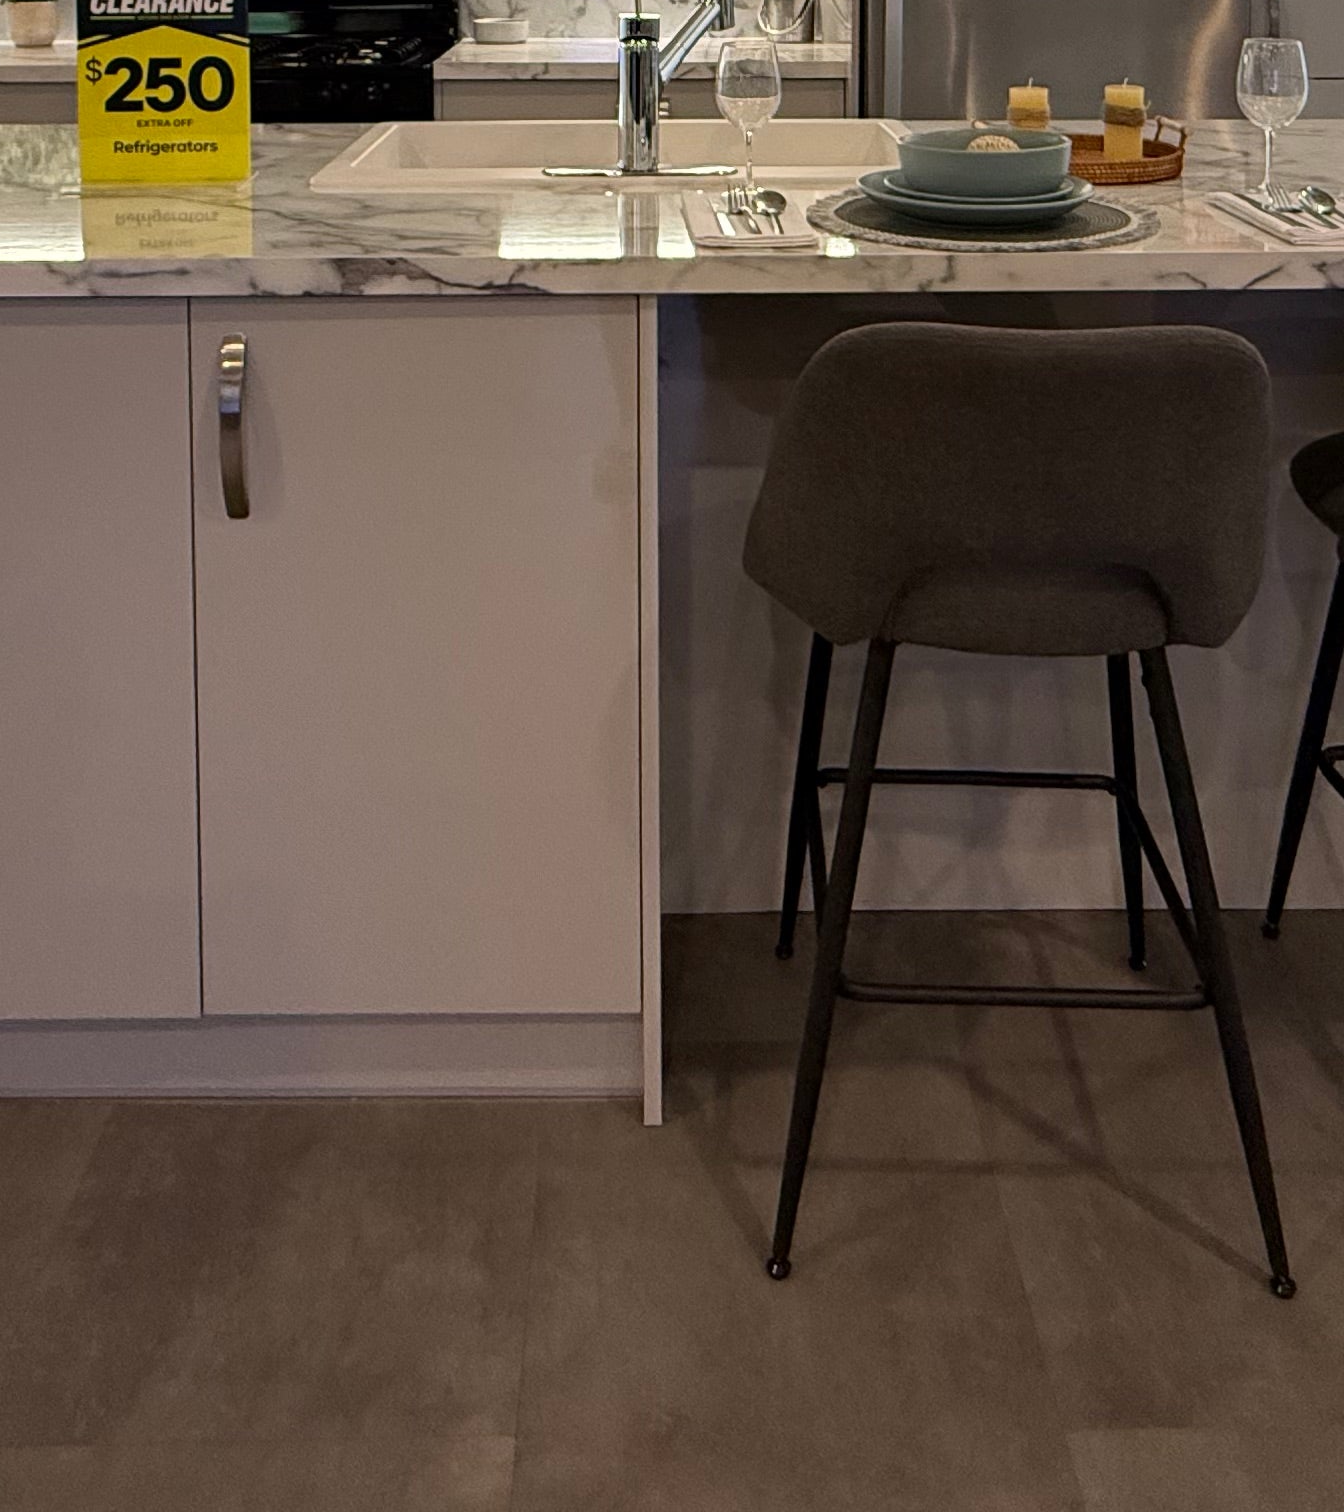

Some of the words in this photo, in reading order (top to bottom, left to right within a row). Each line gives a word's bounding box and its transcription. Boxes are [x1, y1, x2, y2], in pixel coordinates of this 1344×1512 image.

[85, 55, 235, 113] $250
[136, 118, 172, 128] EXTRA
[172, 118, 194, 128] OFF
[113, 140, 219, 156] Refrigerators
